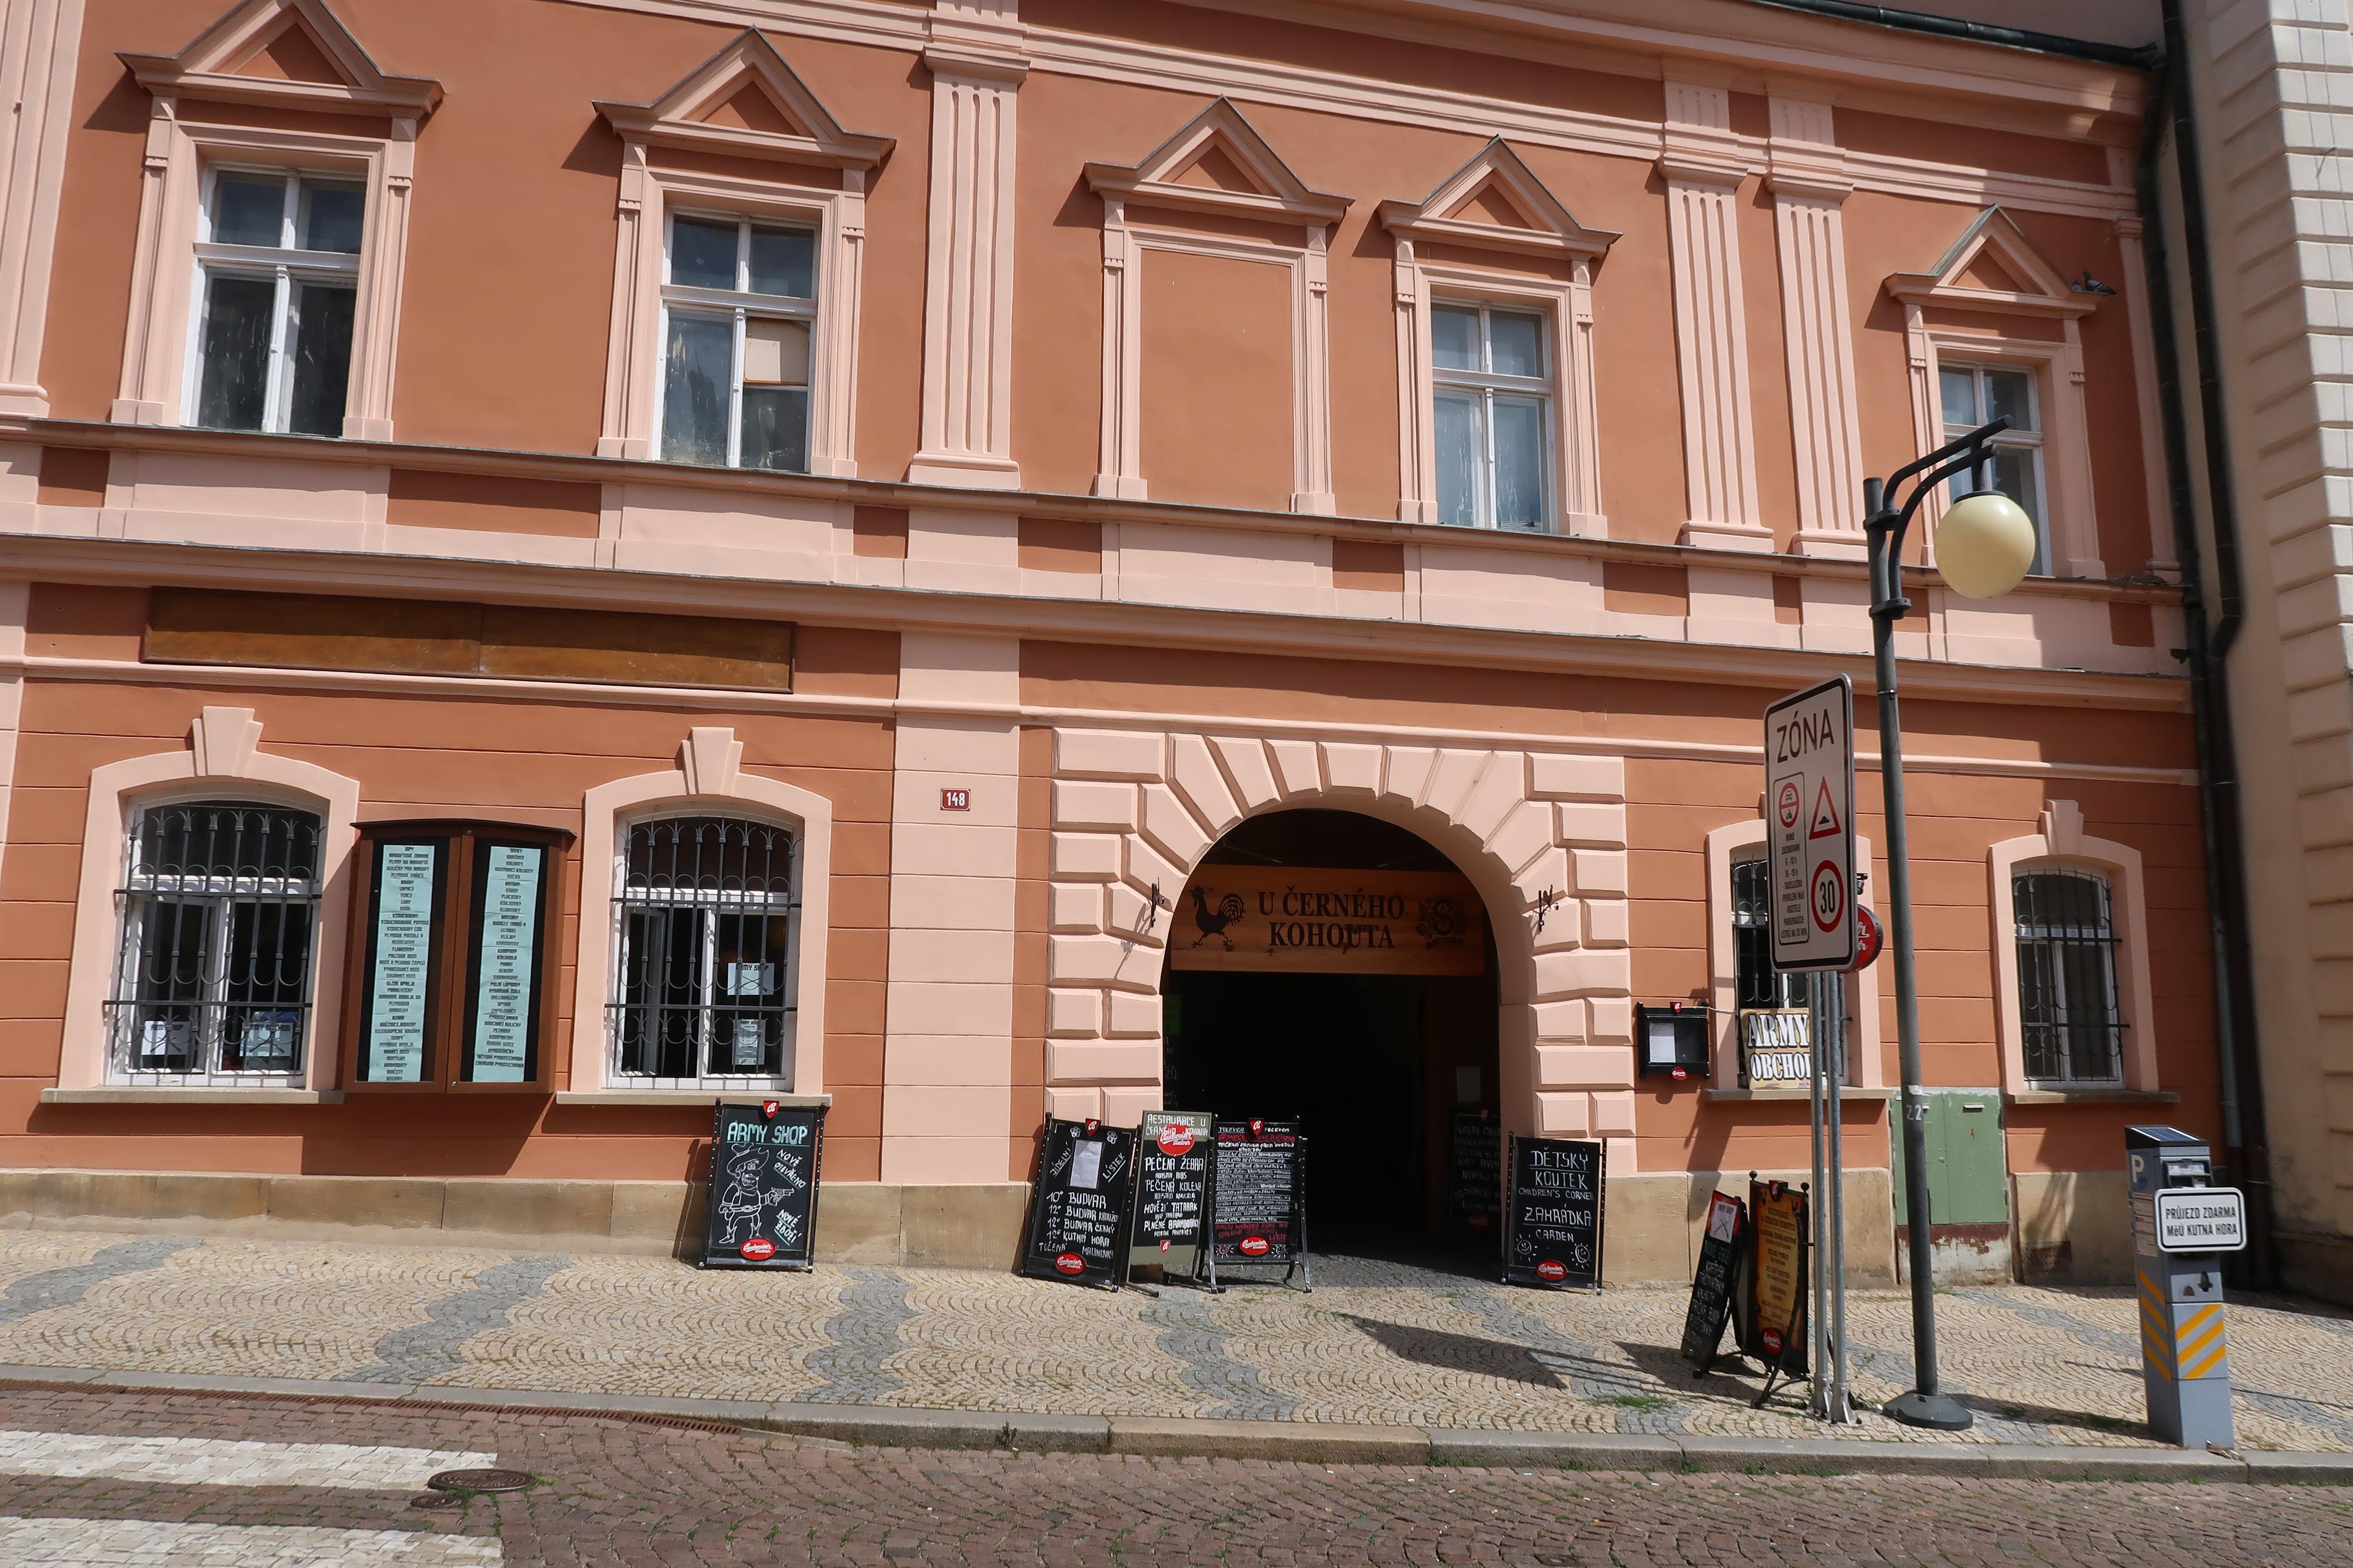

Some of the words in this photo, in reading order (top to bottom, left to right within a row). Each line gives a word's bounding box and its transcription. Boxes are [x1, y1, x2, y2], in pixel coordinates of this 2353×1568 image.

[1777, 709, 1834, 763] ZÓNA
[946, 792, 965, 806] 148
[1258, 892, 1276, 915] U
[1282, 885, 1405, 919] ČERNÉHO
[1820, 880, 1835, 914] 30
[1269, 922, 1395, 948] KOHOUTA
[1748, 1014, 1809, 1048] ARMY
[1148, 1114, 1195, 1126] RESTAURACE
[1201, 1119, 1206, 1127] U
[1906, 1105, 1922, 1120] 22
[727, 1122, 768, 1142] ARMY
[772, 1125, 808, 1145] SHOP
[776, 1149, 804, 1166] NOVĚ
[1050, 1141, 1071, 1176] JÍDELNÍ
[1102, 1153, 1125, 1179] LÍSTEK
[1145, 1153, 1176, 1171] PEČENÁ
[1181, 1156, 1204, 1171] ŽEBRA
[1529, 1146, 1588, 1170] DĚTSKÝ
[2131, 1155, 2144, 1183] P
[1145, 1179, 1175, 1192] PEČENÁ
[1535, 1171, 1588, 1190] KOUTEK
[1046, 1190, 1064, 1202] 10°
[1068, 1192, 1106, 1209] BUDVAR
[1518, 1187, 1561, 1199] CHILDREN'S
[1565, 1190, 1594, 1202] CORNER
[1049, 1205, 1061, 1214] 12°
[1065, 1206, 1096, 1221] BUDVAR
[1144, 1200, 1168, 1214] HOVĚZÍ
[1524, 1203, 1592, 1226] ZAHRÁDKA
[2203, 1207, 2236, 1218] ZDARMA
[777, 1209, 802, 1227] NOVÉ
[1048, 1217, 1060, 1228] 12°
[1064, 1219, 1093, 1233] BUDVAR
[1095, 1223, 1115, 1234] ČERNÝ
[1144, 1218, 1166, 1232] PLNĚNÉ
[775, 1221, 802, 1243] ZBOŽÍ
[2187, 1222, 2213, 1236] KUTNÁ
[2215, 1225, 2237, 1235] HORA
[1064, 1231, 1086, 1243] KUTNÁ
[1092, 1236, 1109, 1247] HORA
